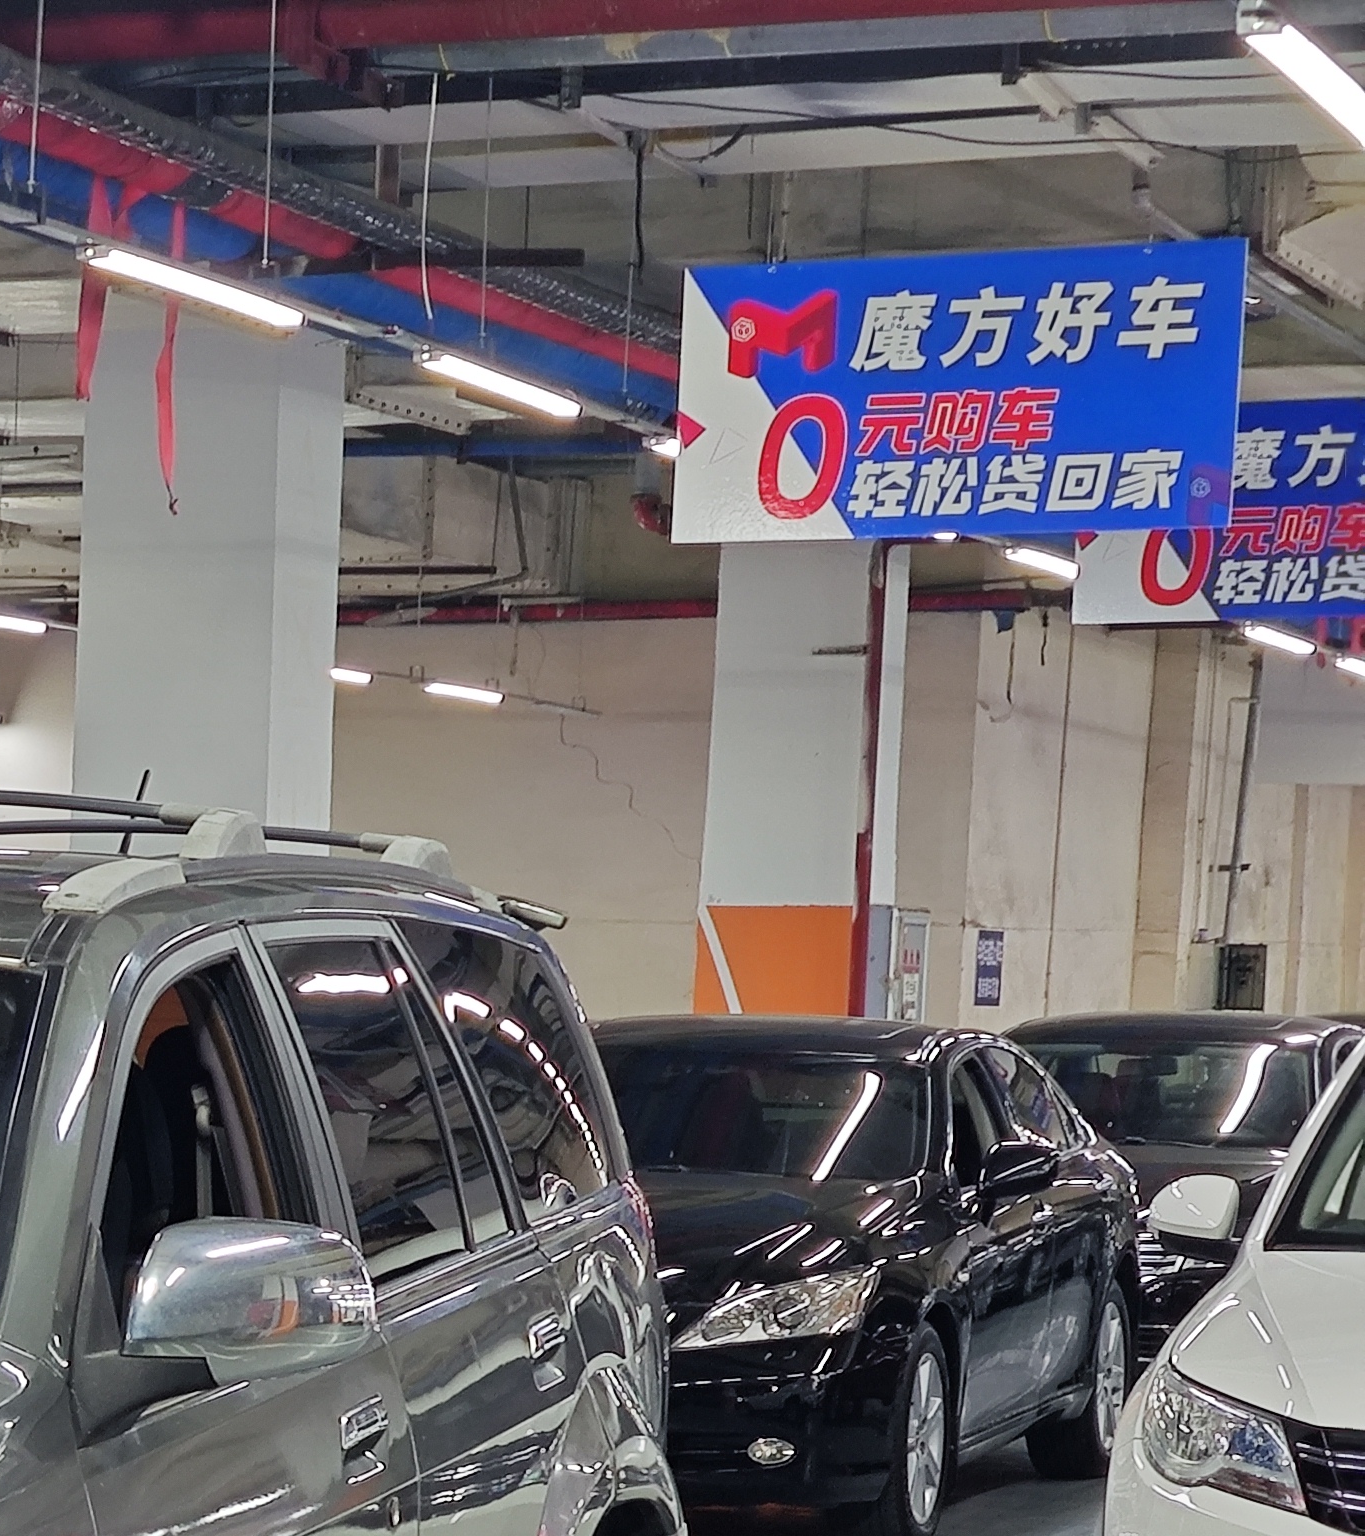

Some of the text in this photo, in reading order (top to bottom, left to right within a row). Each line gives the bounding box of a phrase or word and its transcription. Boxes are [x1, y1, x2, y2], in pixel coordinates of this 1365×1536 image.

[848, 275, 1206, 373] 魔方好车
[855, 386, 1061, 457] 元购车
[1234, 423, 1365, 490] 魔方
[846, 448, 1184, 520] 轻松贷回家
